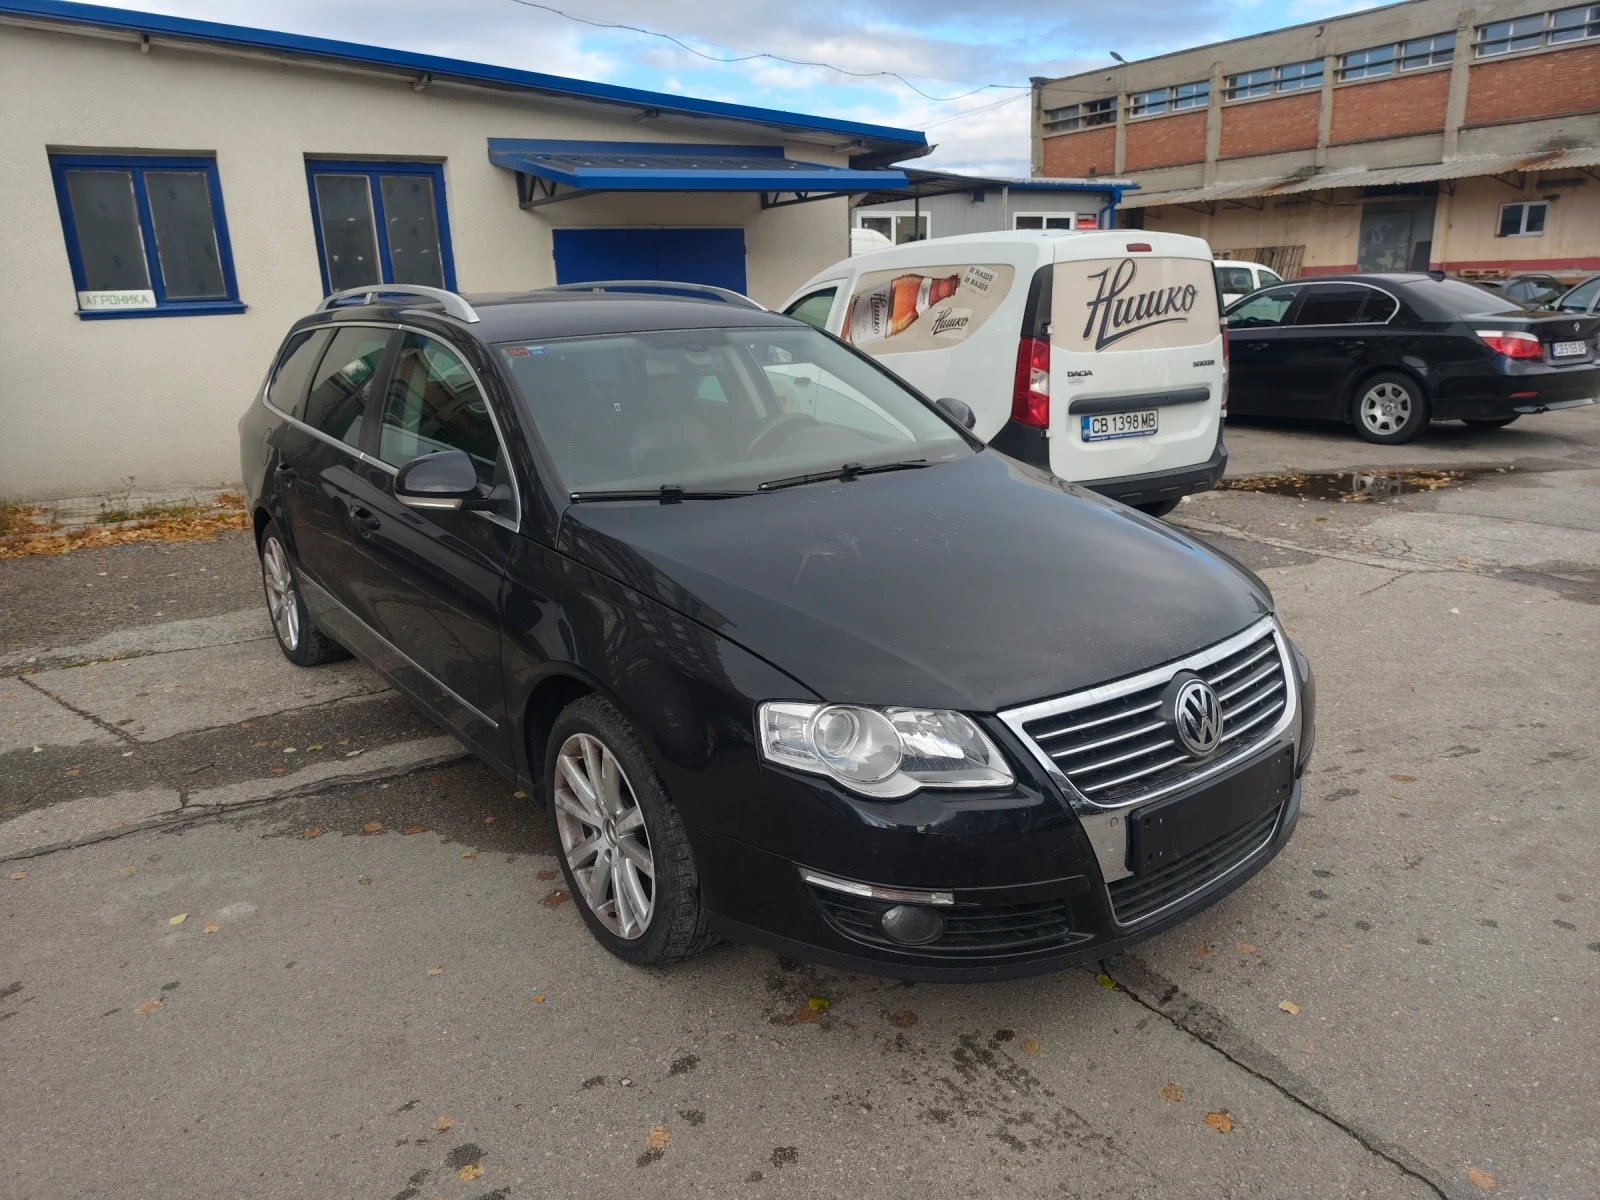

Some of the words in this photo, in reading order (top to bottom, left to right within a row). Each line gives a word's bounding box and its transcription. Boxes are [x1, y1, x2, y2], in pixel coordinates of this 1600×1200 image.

[969, 278, 989, 291] ВАШЕ
[975, 268, 993, 282] НАШЕ
[86, 294, 149, 305] АГРОНИКА
[1083, 258, 1197, 352] Нишко
[870, 290, 887, 335] Нишко
[931, 307, 969, 336] Нишко
[1092, 417, 1109, 434] CB
[1112, 414, 1139, 432] 1398
[1141, 412, 1156, 428] MB
